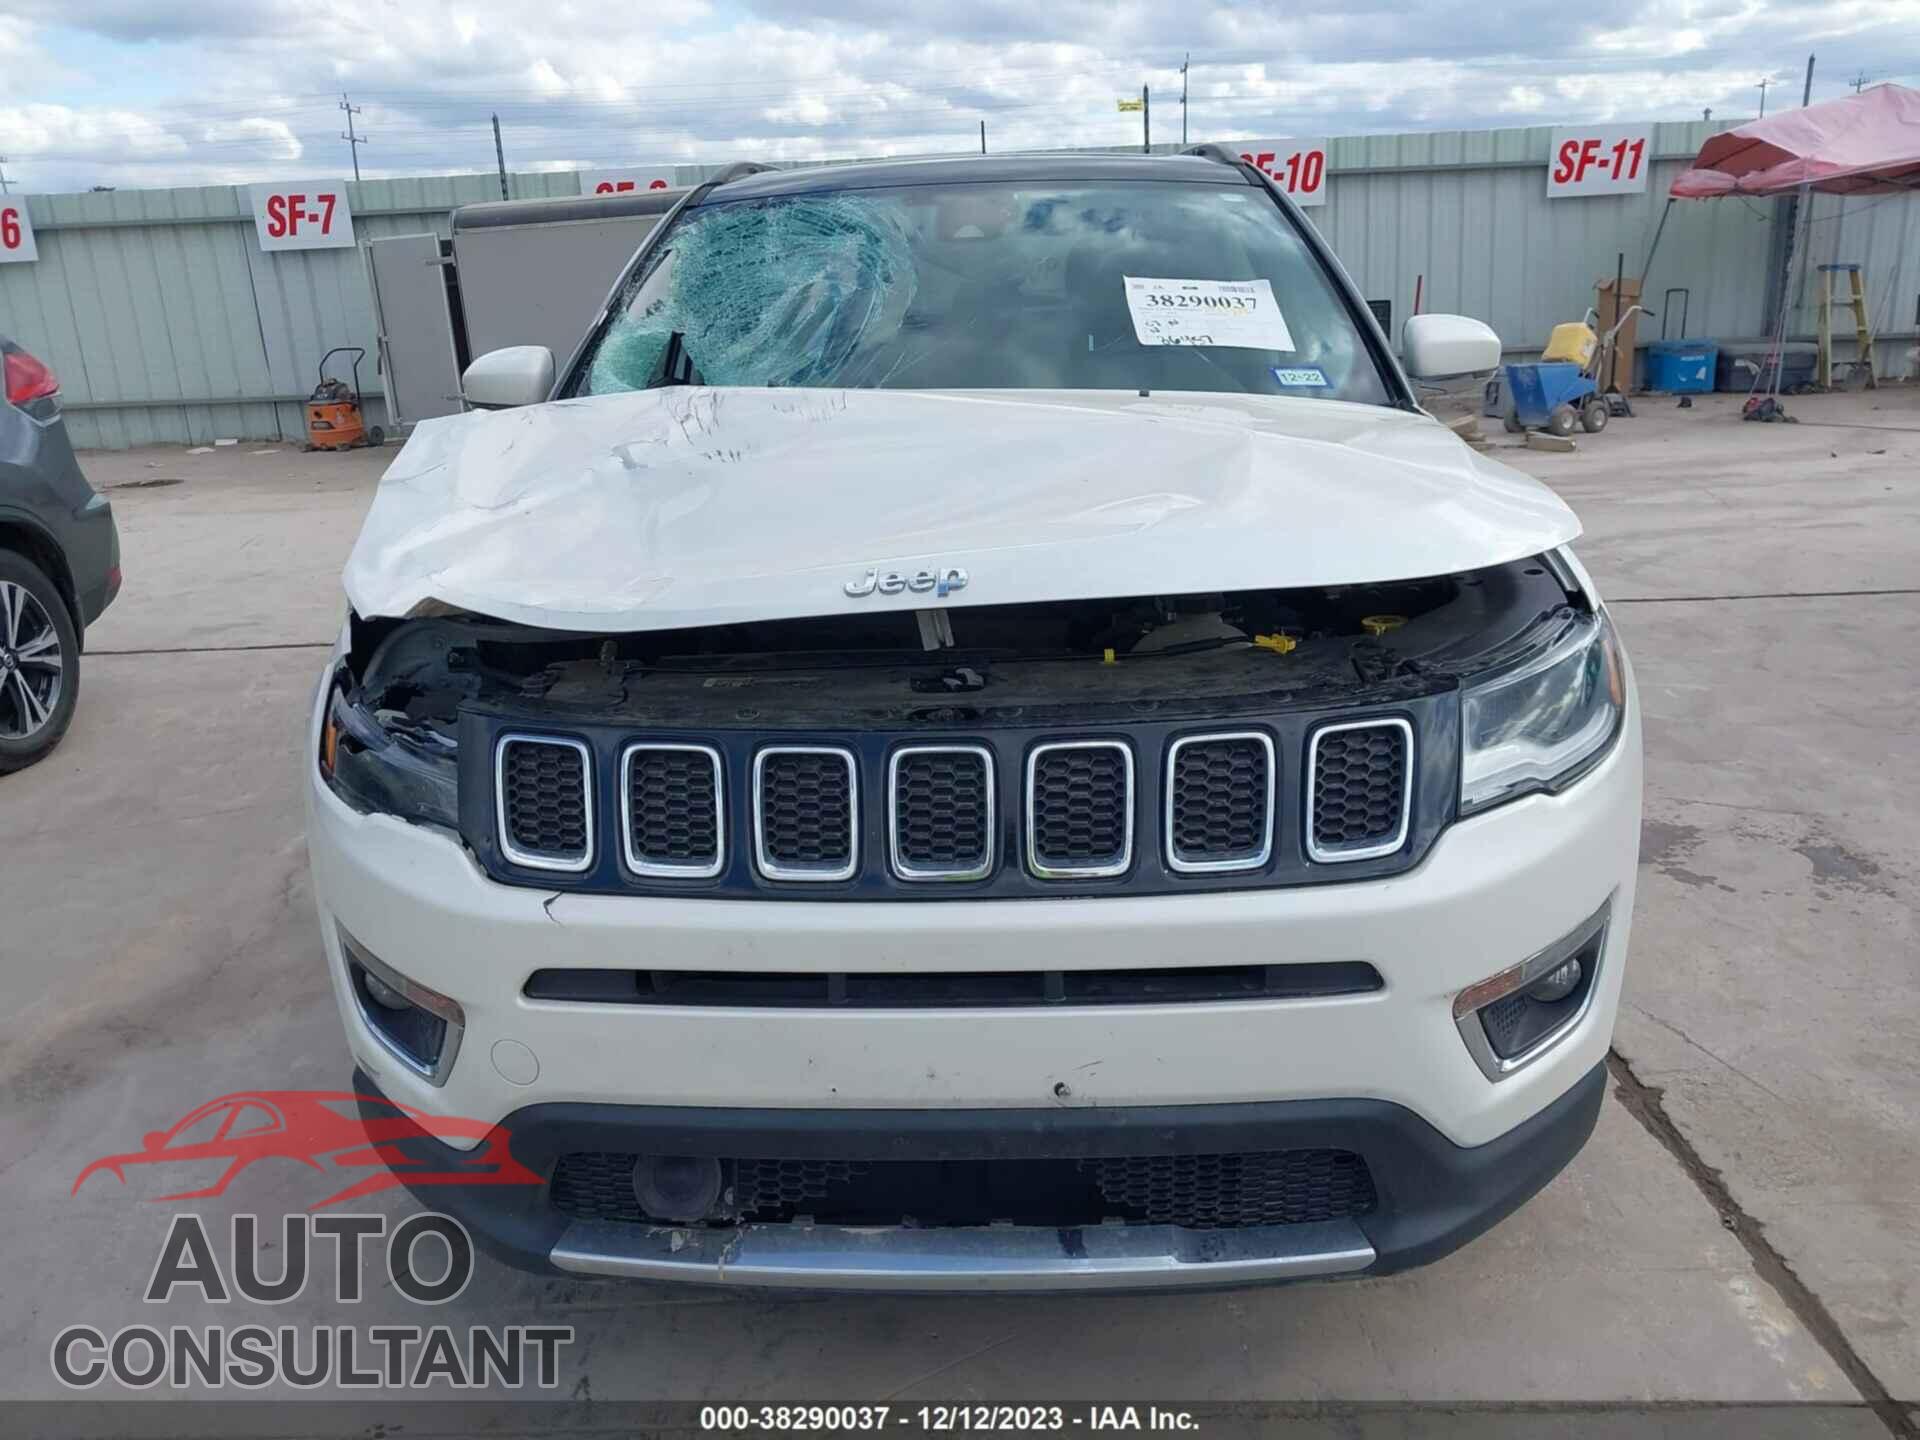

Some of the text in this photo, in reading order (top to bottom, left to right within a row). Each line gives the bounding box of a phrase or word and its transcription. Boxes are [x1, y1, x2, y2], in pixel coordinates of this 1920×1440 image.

[1241, 151, 1323, 193] F-10
[1554, 138, 1645, 183] SF-11
[267, 194, 336, 237] SF-7
[1145, 293, 1257, 309] 38290037
[843, 567, 968, 598] Jeep
